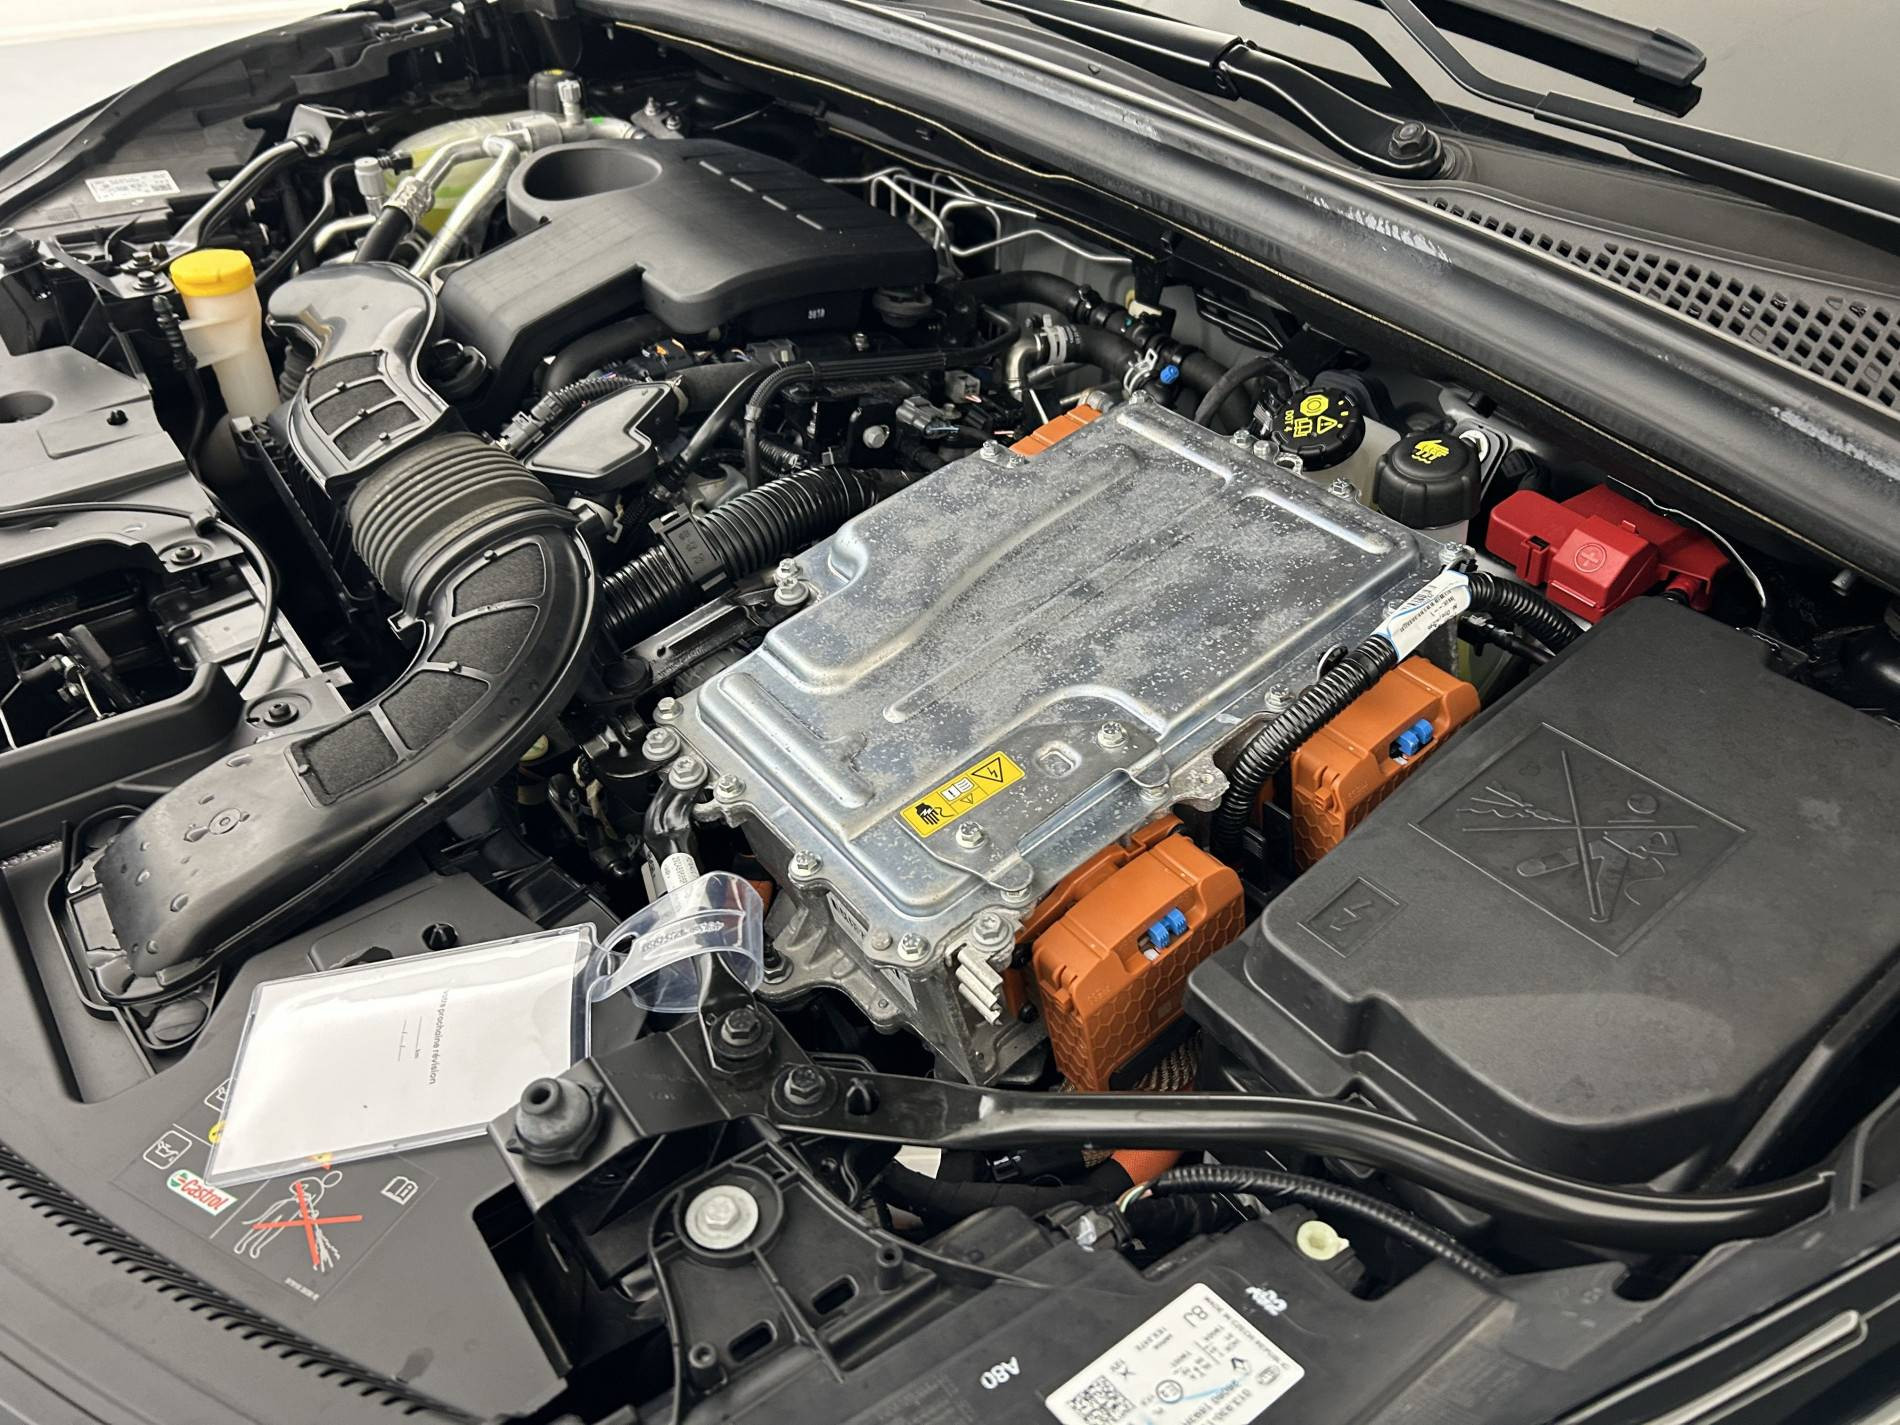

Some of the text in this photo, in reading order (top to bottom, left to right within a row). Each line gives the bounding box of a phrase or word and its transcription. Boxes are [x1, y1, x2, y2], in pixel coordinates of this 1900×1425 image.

[1285, 410, 1294, 424] DOT
[180, 1179, 230, 1211] Castrol
[1183, 1305, 1208, 1328] 8J
[980, 1356, 1020, 1389] A80
